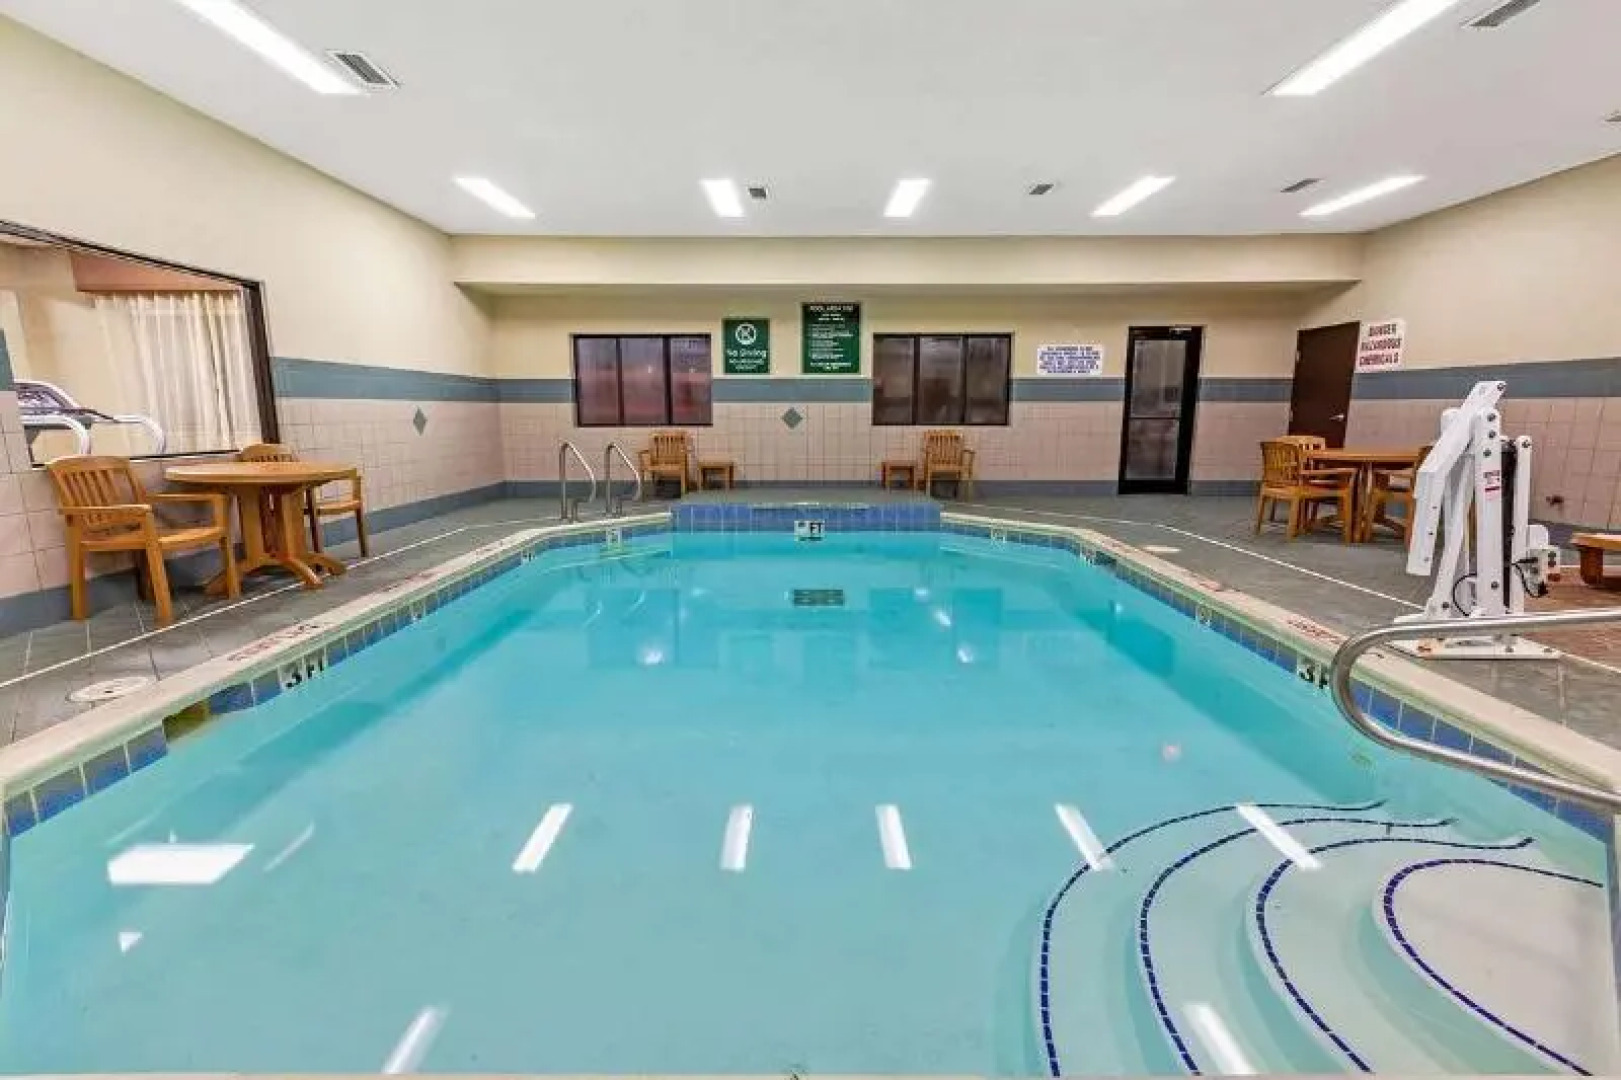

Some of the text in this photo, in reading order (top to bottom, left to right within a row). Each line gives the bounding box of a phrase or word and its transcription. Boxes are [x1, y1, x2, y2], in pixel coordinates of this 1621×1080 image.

[1369, 324, 1397, 336] DANGER
[1361, 338, 1401, 350] HAZARDOUS
[1359, 353, 1399, 367] CHEMICALS
